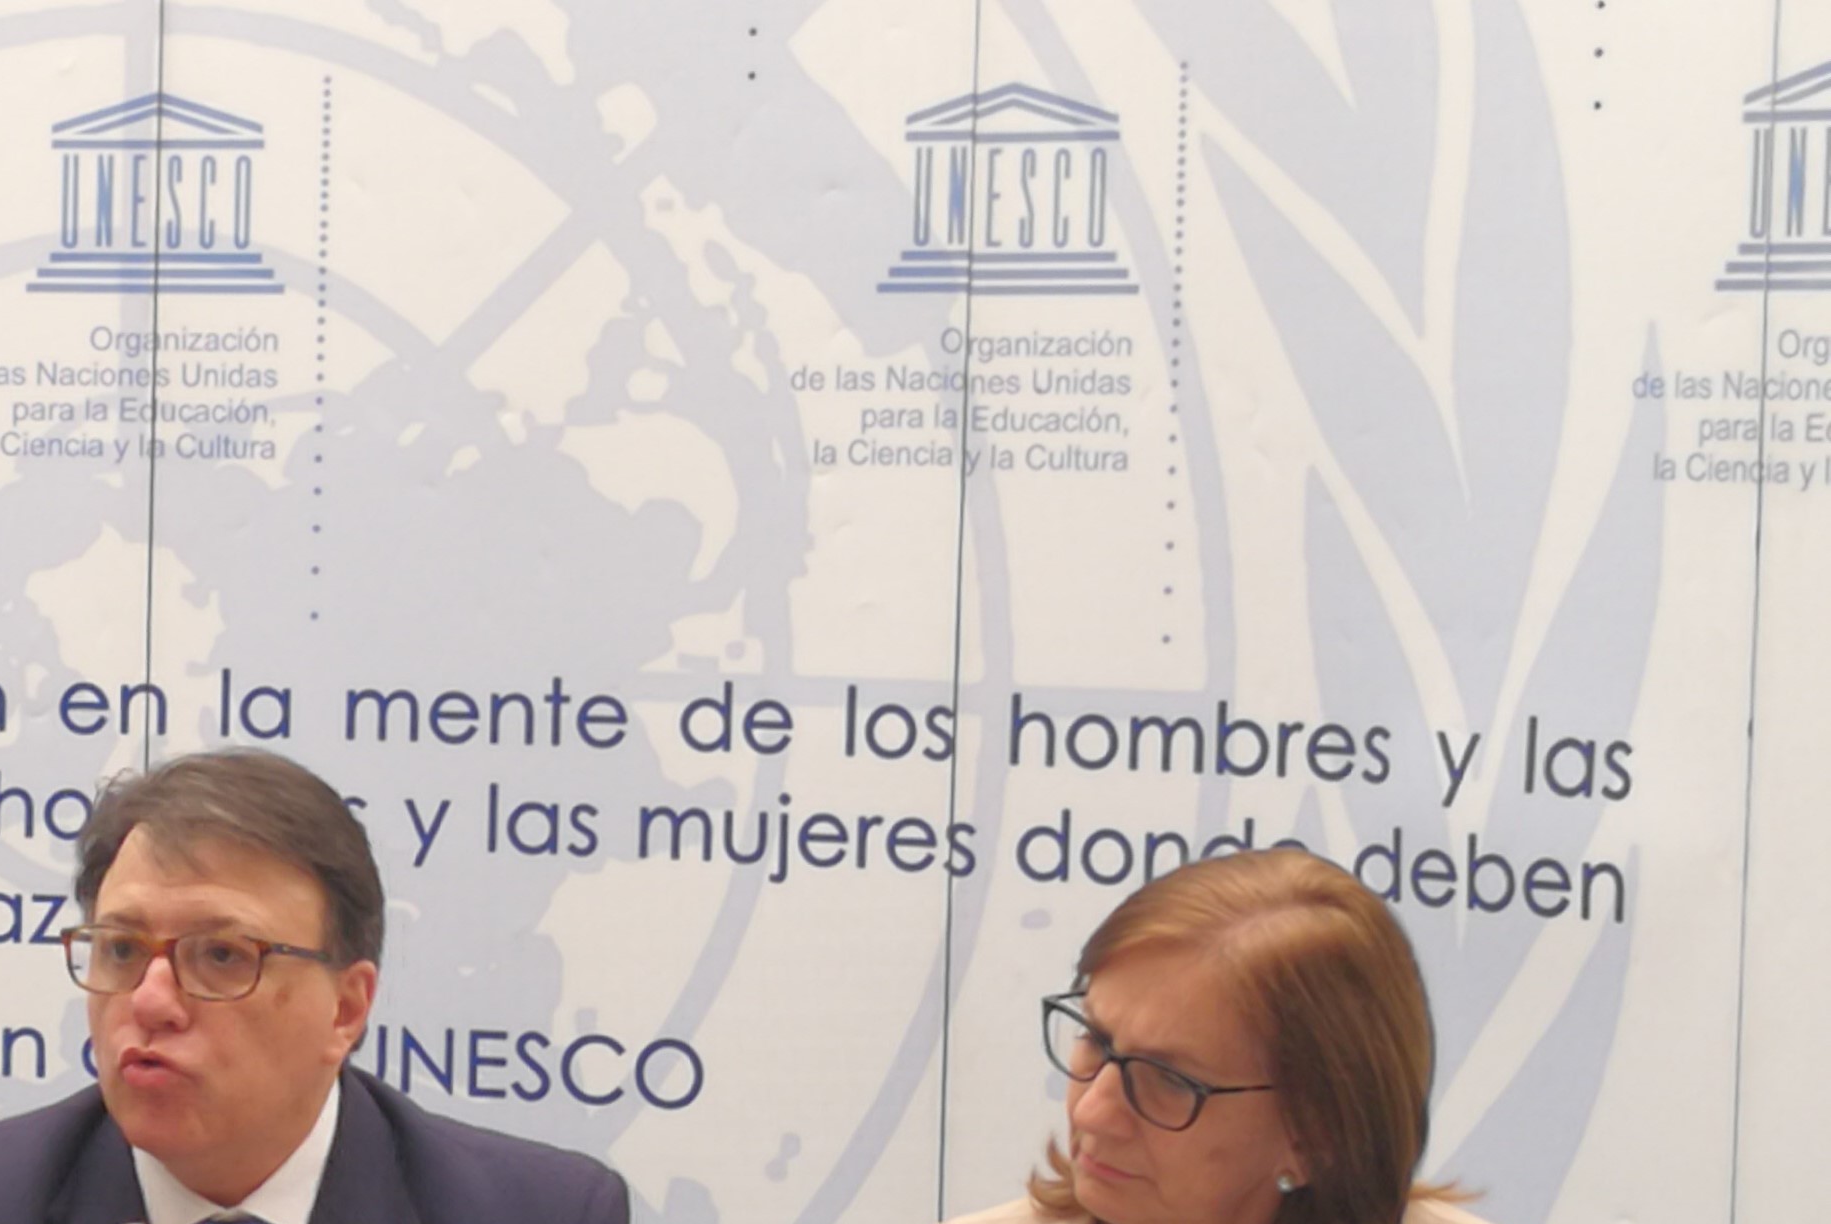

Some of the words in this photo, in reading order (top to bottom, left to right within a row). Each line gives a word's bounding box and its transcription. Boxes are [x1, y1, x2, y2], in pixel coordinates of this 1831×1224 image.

[61, 154, 251, 249] UNESCO
[913, 146, 1107, 249] UNESCO
[90, 325, 278, 359] Organización
[940, 326, 1133, 363] Organización
[36, 361, 171, 389] Naciones
[181, 362, 278, 390] Unidas
[790, 366, 825, 394] de
[835, 366, 876, 394] las
[885, 366, 1020, 397] Naciones
[1032, 368, 1131, 398] Unidas
[1632, 371, 1665, 399] de
[1674, 371, 1711, 399] las
[1722, 371, 1831, 400] Nacione
[12, 401, 76, 427] para
[84, 397, 109, 423] la
[119, 394, 277, 427] Educación,
[860, 408, 924, 436] para
[933, 404, 958, 431] la
[970, 400, 1129, 439] Educación,
[1699, 417, 1759, 447] para
[1771, 412, 1793, 442] la
[0, 432, 104, 459] Ciencia
[114, 441, 129, 466] y
[140, 433, 164, 459] la
[175, 432, 277, 461] Cultura
[813, 440, 837, 466] la
[848, 440, 954, 469] Ciencia
[965, 447, 981, 476] y
[990, 442, 1013, 470] la
[1025, 442, 1129, 472] Cultura
[1654, 452, 1676, 480] la
[1686, 452, 1789, 483] Ciencia
[1800, 461, 1815, 492] y
[59, 680, 167, 736] en
[221, 668, 292, 738] la
[345, 677, 628, 751] mente
[679, 681, 793, 754] de
[845, 685, 957, 762] los
[1009, 693, 1392, 784] hombres
[1437, 730, 1481, 808] y
[1526, 716, 1633, 799] las
[407, 795, 449, 867] y
[487, 785, 598, 857] las
[639, 793, 976, 883] mujeres
[1354, 827, 1624, 922] deben
